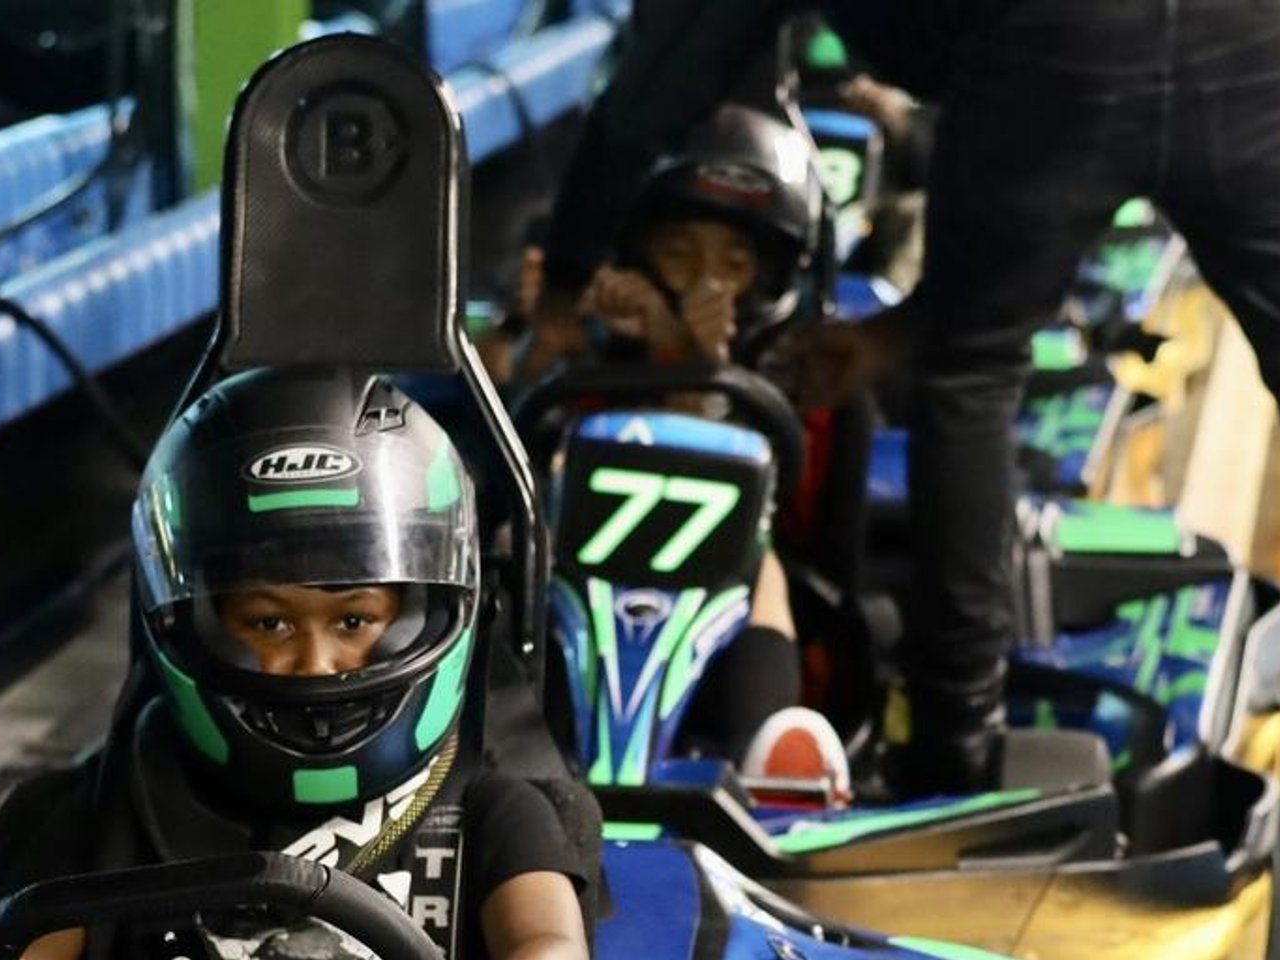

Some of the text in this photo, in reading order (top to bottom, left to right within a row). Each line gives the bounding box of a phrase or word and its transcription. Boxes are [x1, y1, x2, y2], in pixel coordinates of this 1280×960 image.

[320, 110, 373, 179] B
[258, 453, 343, 477] HJC
[577, 467, 741, 572] 77
